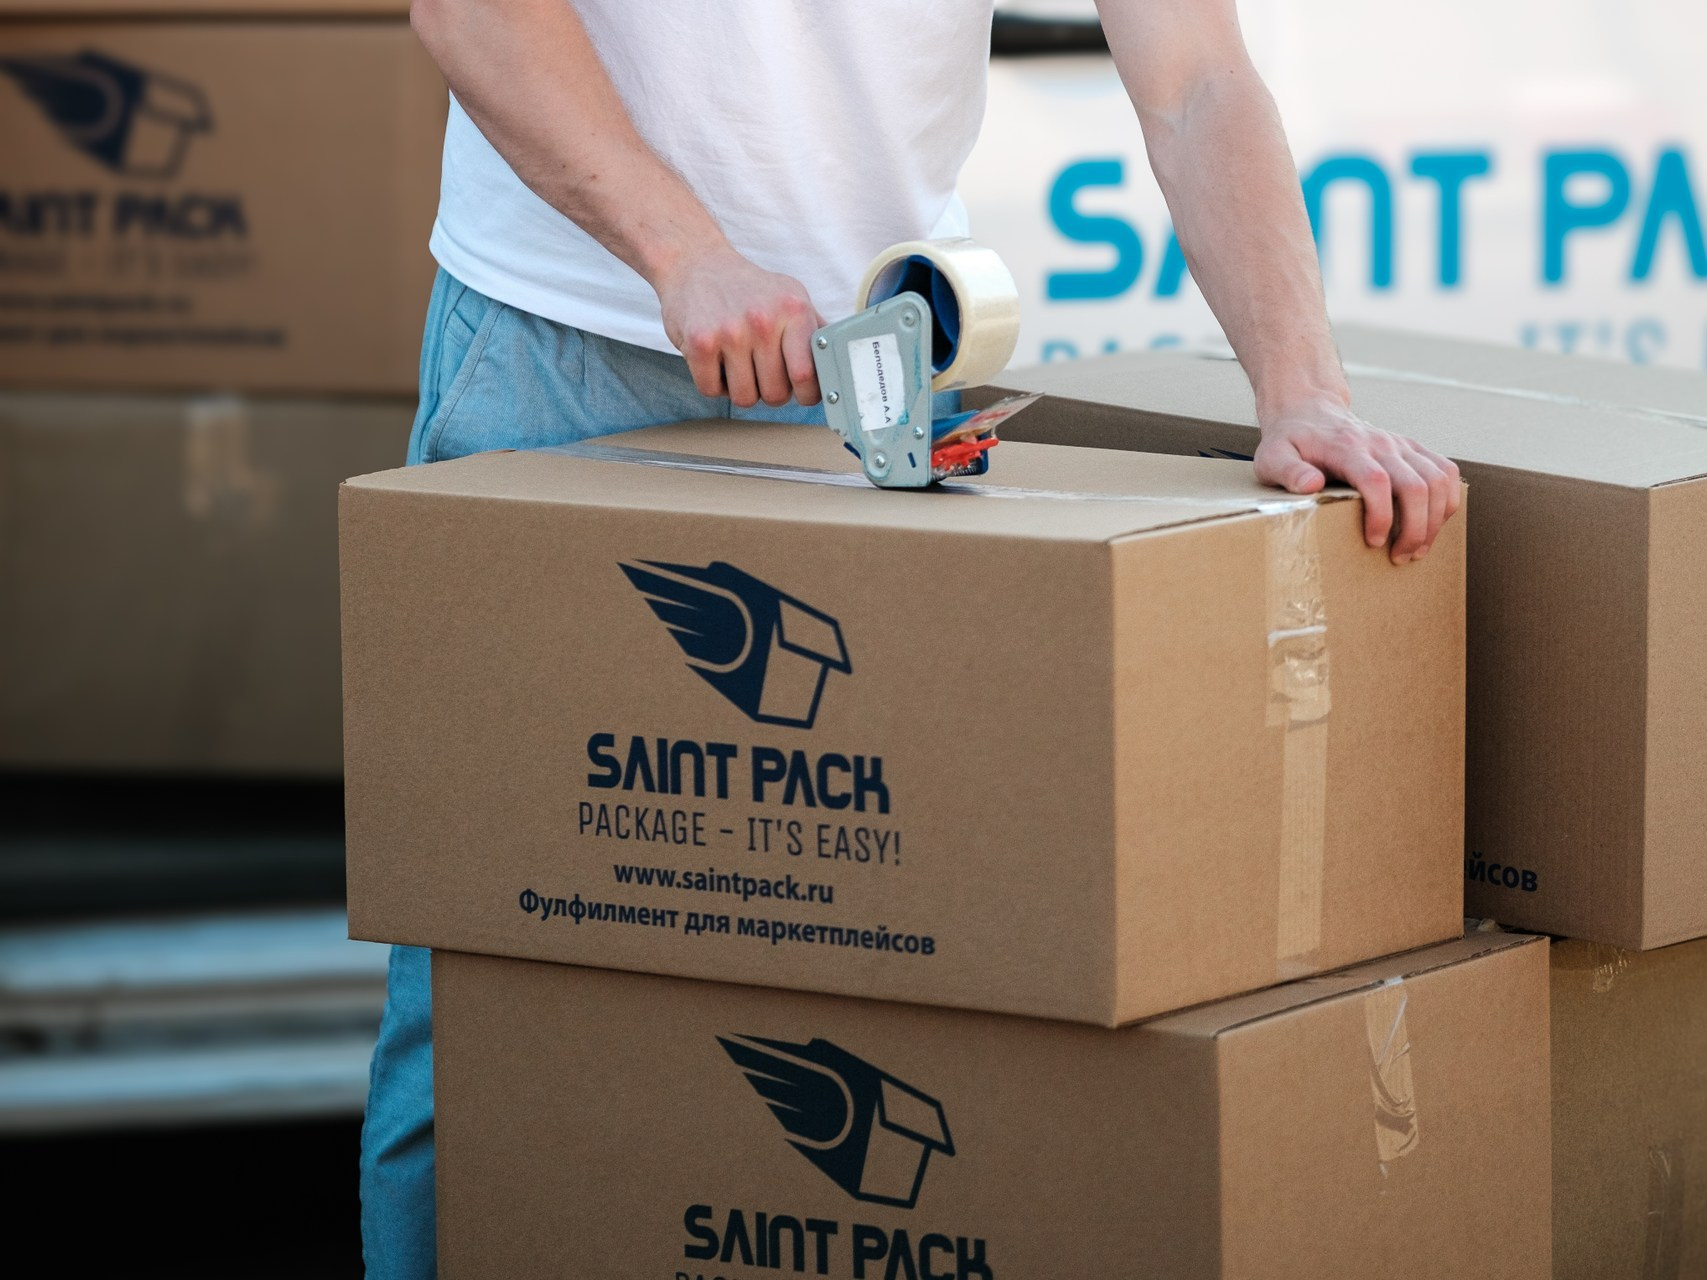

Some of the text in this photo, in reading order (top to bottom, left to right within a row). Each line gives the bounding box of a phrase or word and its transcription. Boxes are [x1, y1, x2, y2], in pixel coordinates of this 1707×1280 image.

[1046, 153, 1489, 300] SNT
[587, 733, 890, 814] SAINT PACK
[579, 802, 706, 846] PACKAGE
[747, 817, 803, 856] IT'S
[817, 824, 901, 866] EASY!
[613, 864, 834, 903] www.saintpack.ru
[1464, 851, 1538, 892] йсов
[518, 888, 936, 956] Фулфилмент для маркетплейсов
[683, 1204, 994, 1280] SAINT PACK
